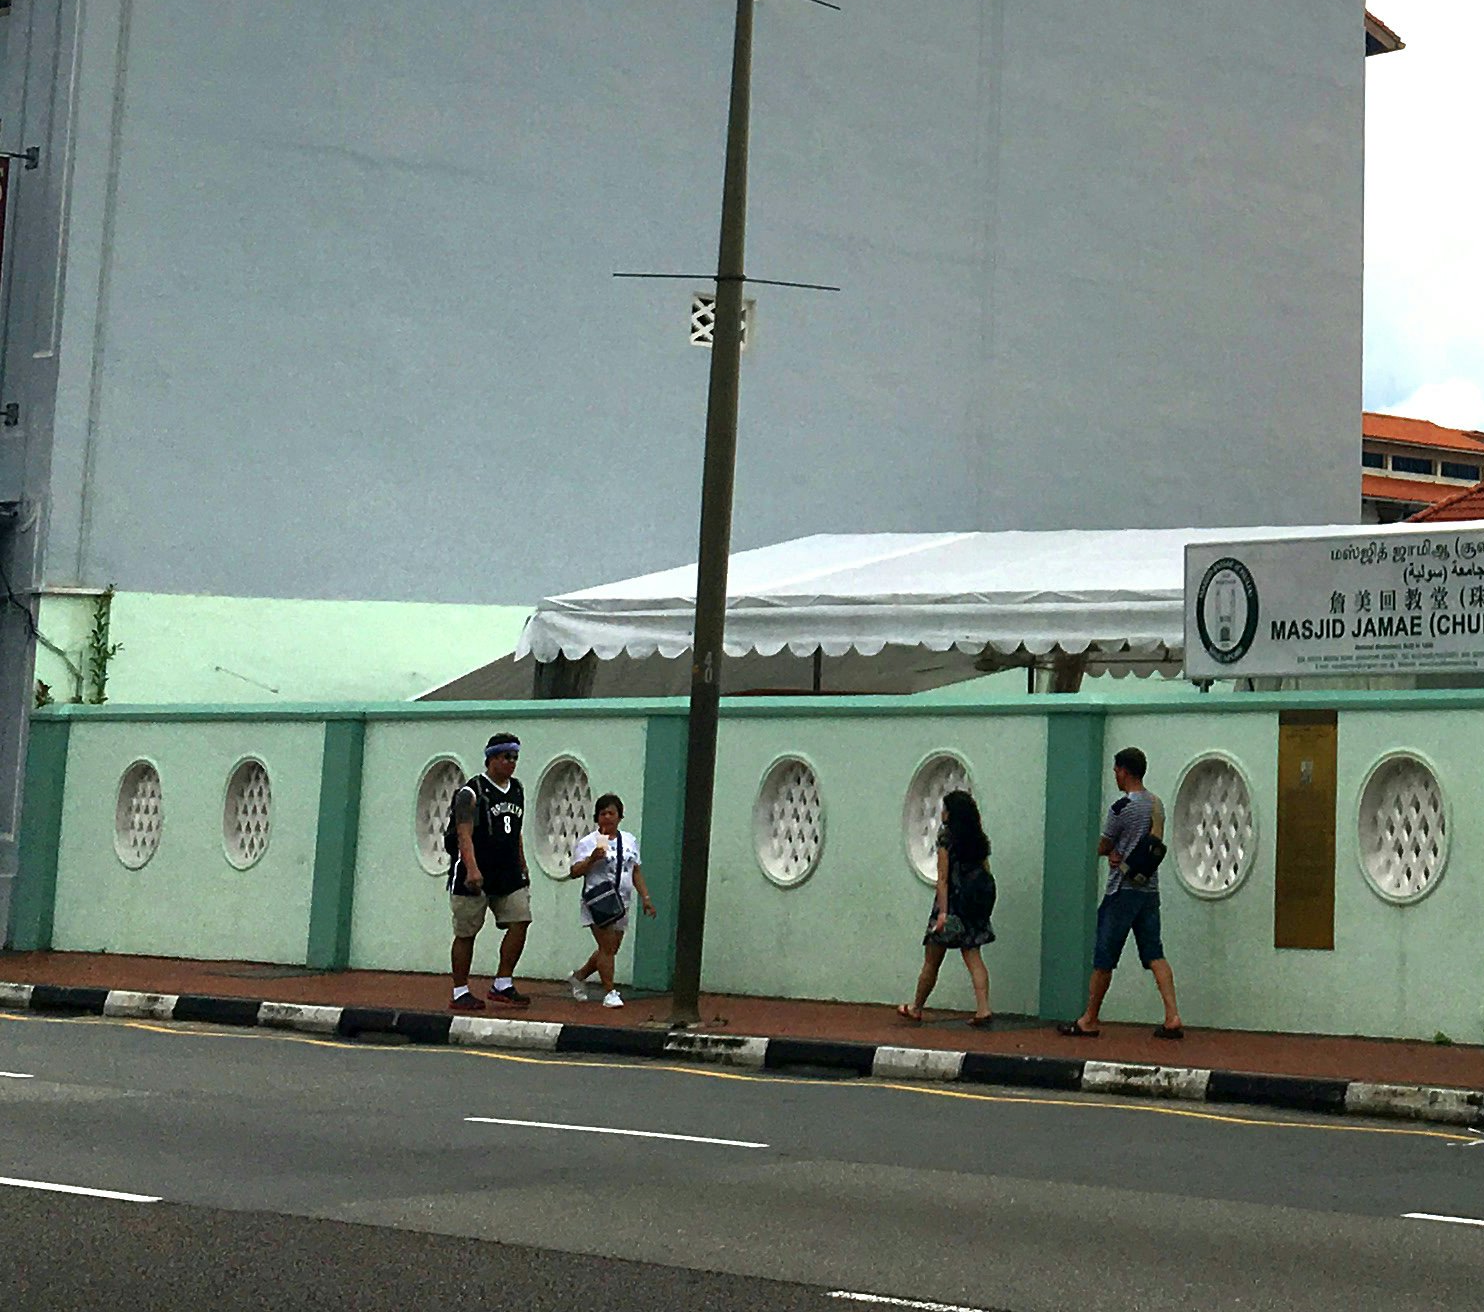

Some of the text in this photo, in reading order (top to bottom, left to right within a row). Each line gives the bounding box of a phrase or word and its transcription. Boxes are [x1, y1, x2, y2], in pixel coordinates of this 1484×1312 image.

[1271, 618, 1345, 640] MASJID
[1351, 615, 1423, 638] JAMAE
[503, 815, 512, 834] 8
